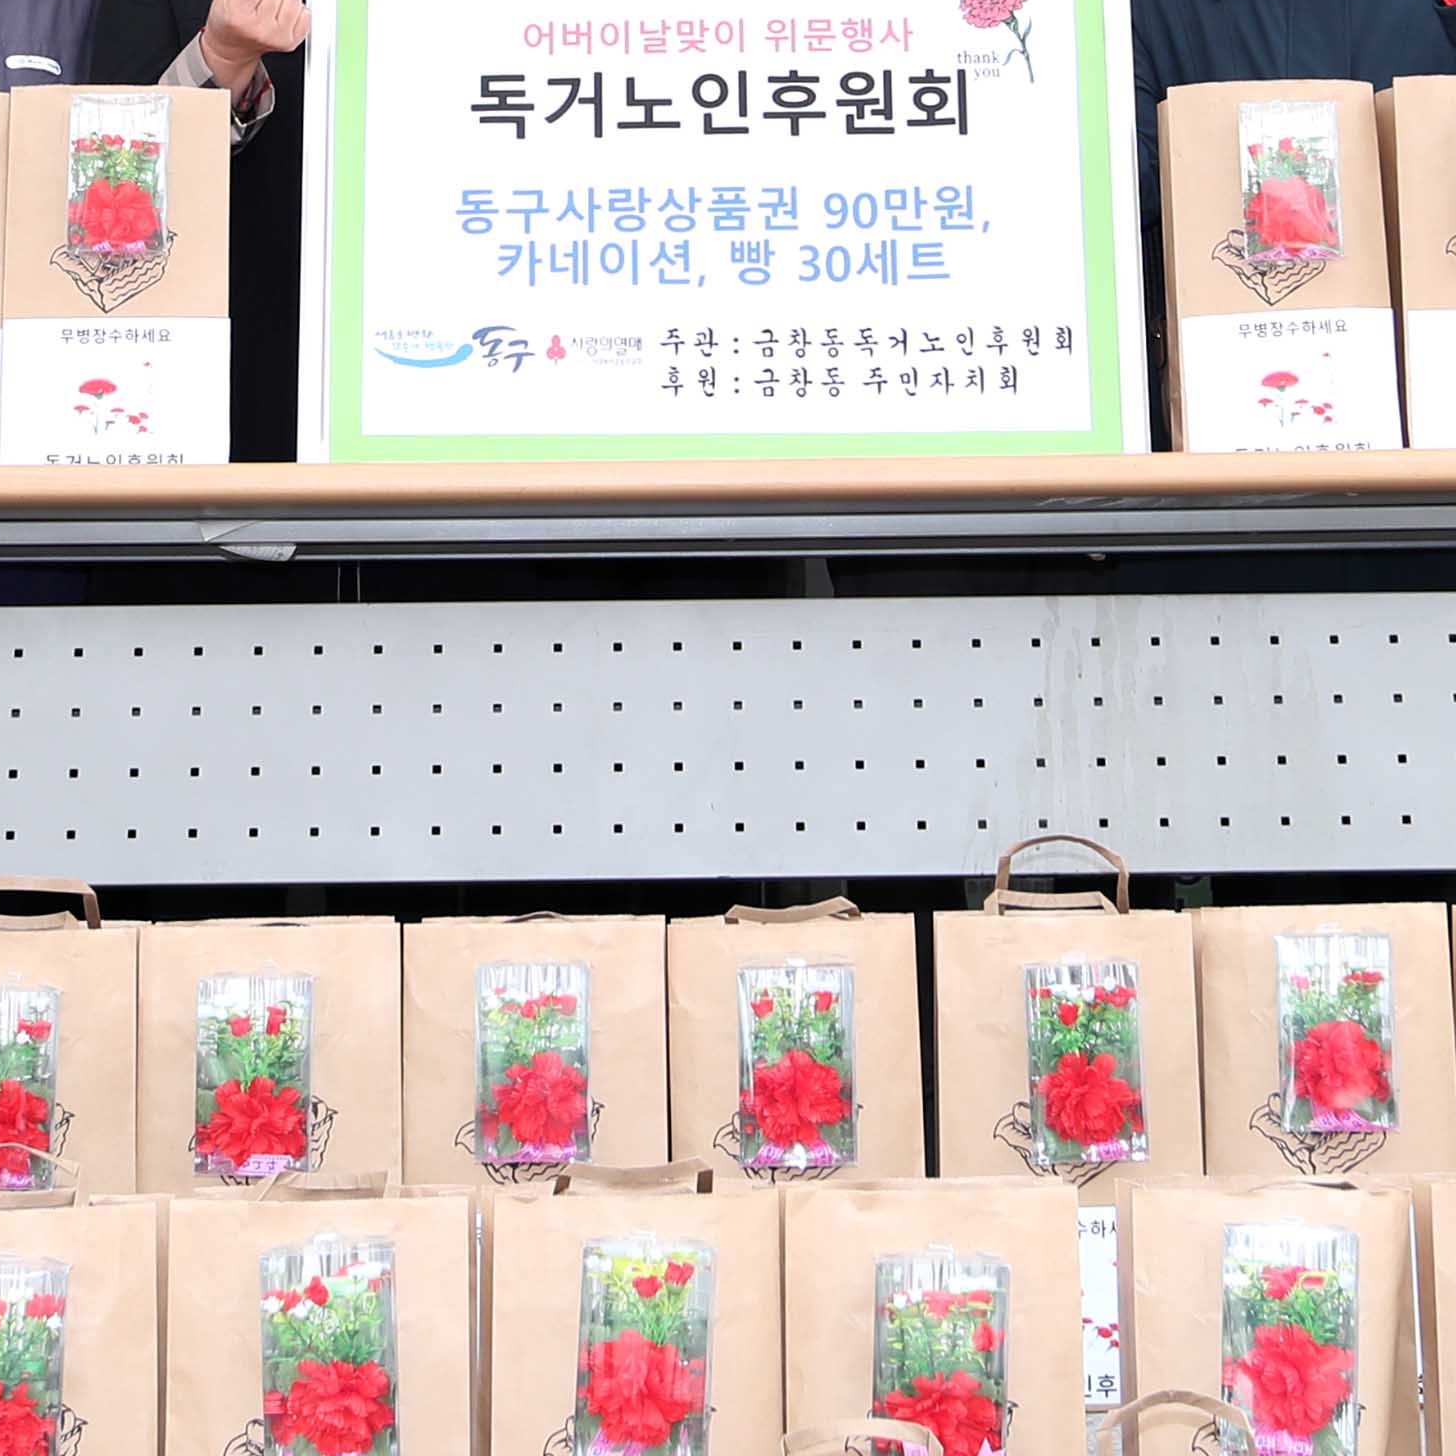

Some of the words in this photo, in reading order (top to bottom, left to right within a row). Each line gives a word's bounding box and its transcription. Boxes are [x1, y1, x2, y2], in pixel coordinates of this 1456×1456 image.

[523, 18, 746, 55] 어버이날맞이
[765, 17, 914, 53] 위문행사
[957, 50, 999, 64] thank
[974, 68, 1000, 80] you
[470, 67, 969, 140] 독거노인후원회
[455, 185, 800, 235] 동구사랑상품권
[823, 184, 991, 233] 90만원,
[497, 239, 706, 288] 카네이션,
[730, 239, 777, 286] 빵
[798, 239, 952, 286] 30세트
[60, 327, 172, 345] 무병장수하세요
[1238, 318, 1348, 338] 무병장수하세요
[470, 325, 536, 373] 동구
[753, 366, 846, 399] 금창동
[862, 364, 1019, 397] 주민자치회
